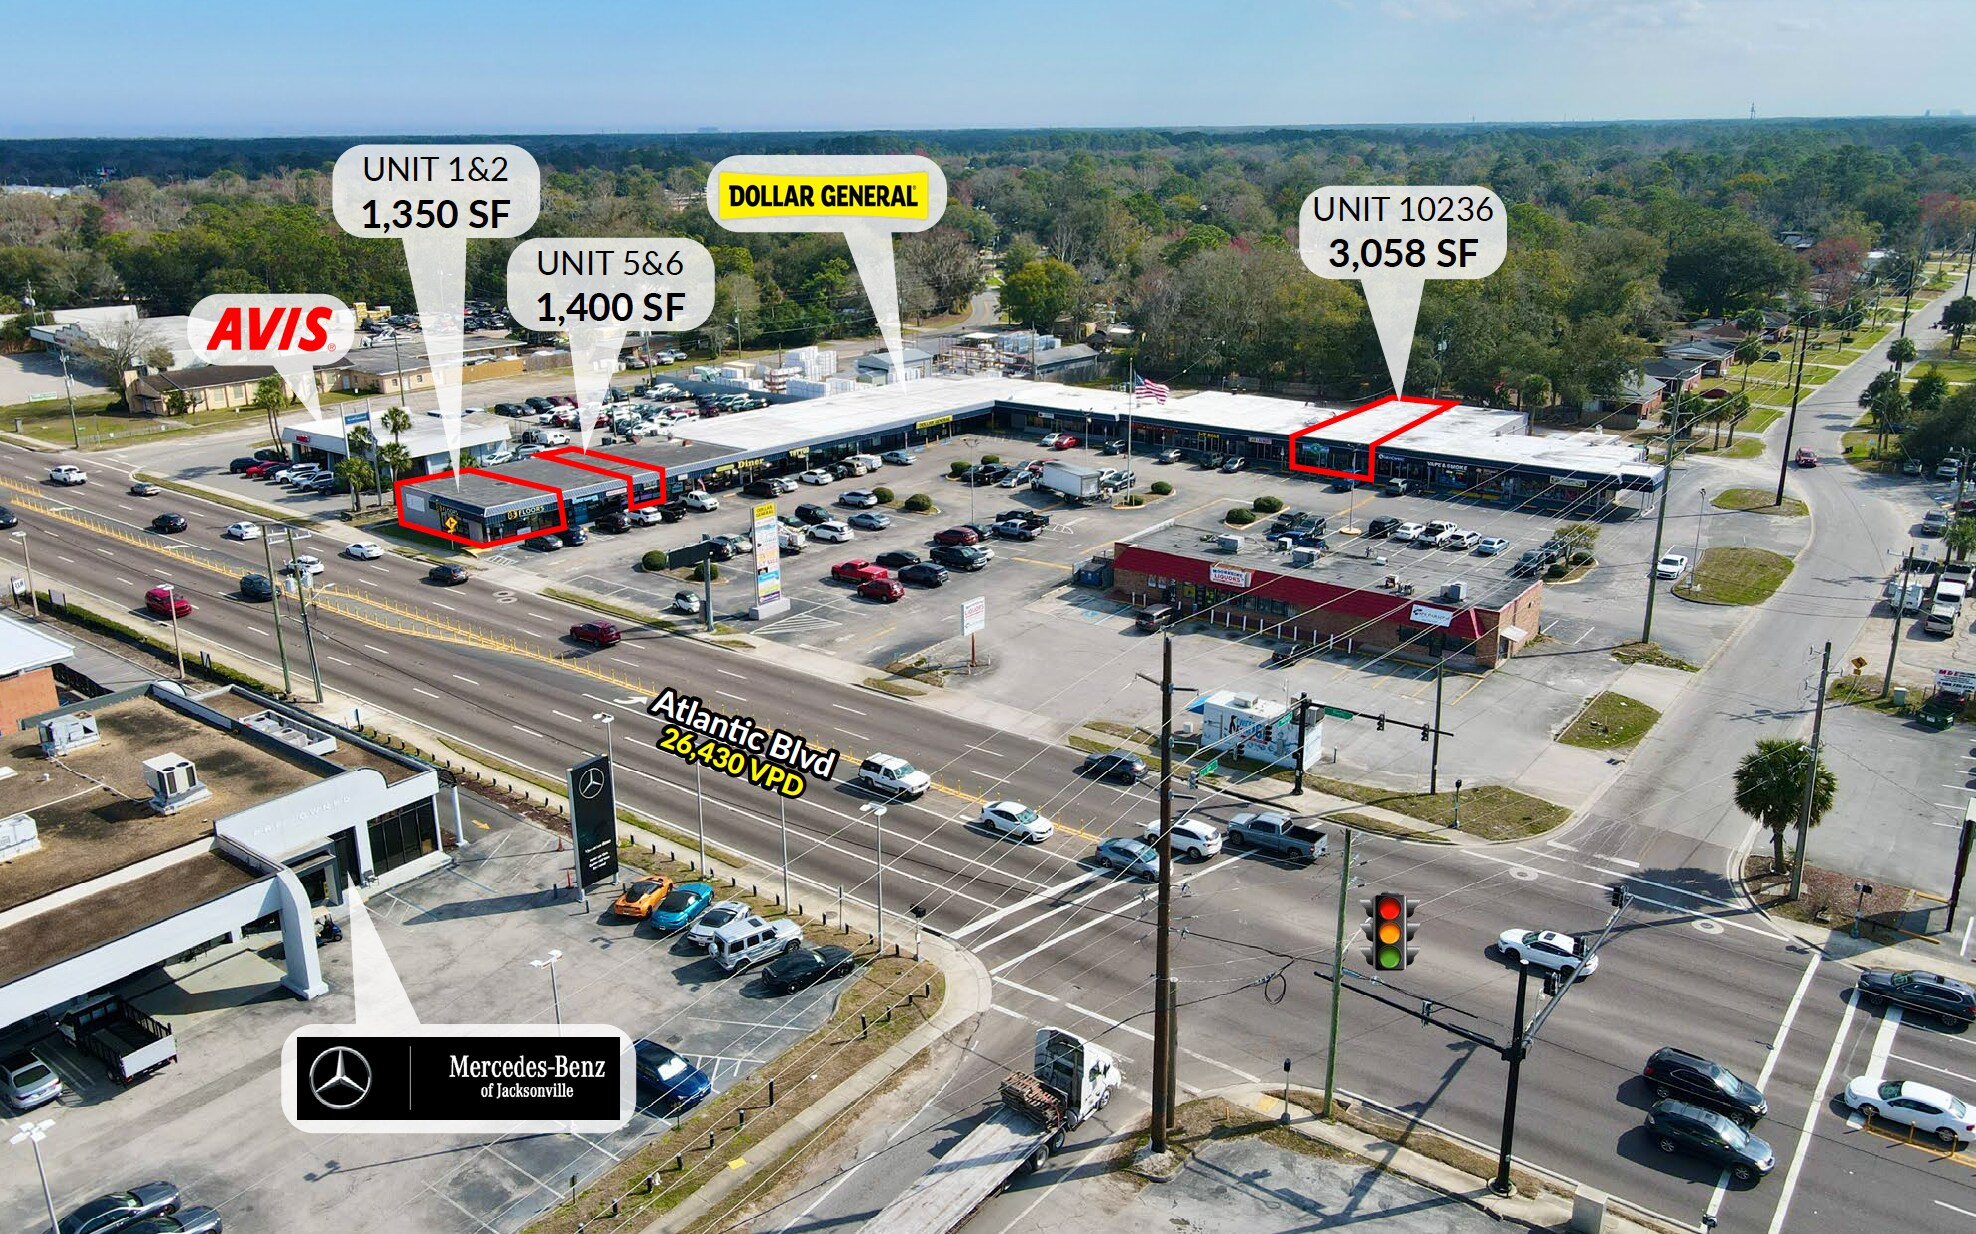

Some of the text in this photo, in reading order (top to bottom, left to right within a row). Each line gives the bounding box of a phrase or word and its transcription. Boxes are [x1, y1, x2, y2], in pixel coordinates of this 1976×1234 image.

[737, 457, 765, 469] Diner
[518, 505, 545, 519] FLOORS
[1214, 573, 1241, 583] LIQUORS
